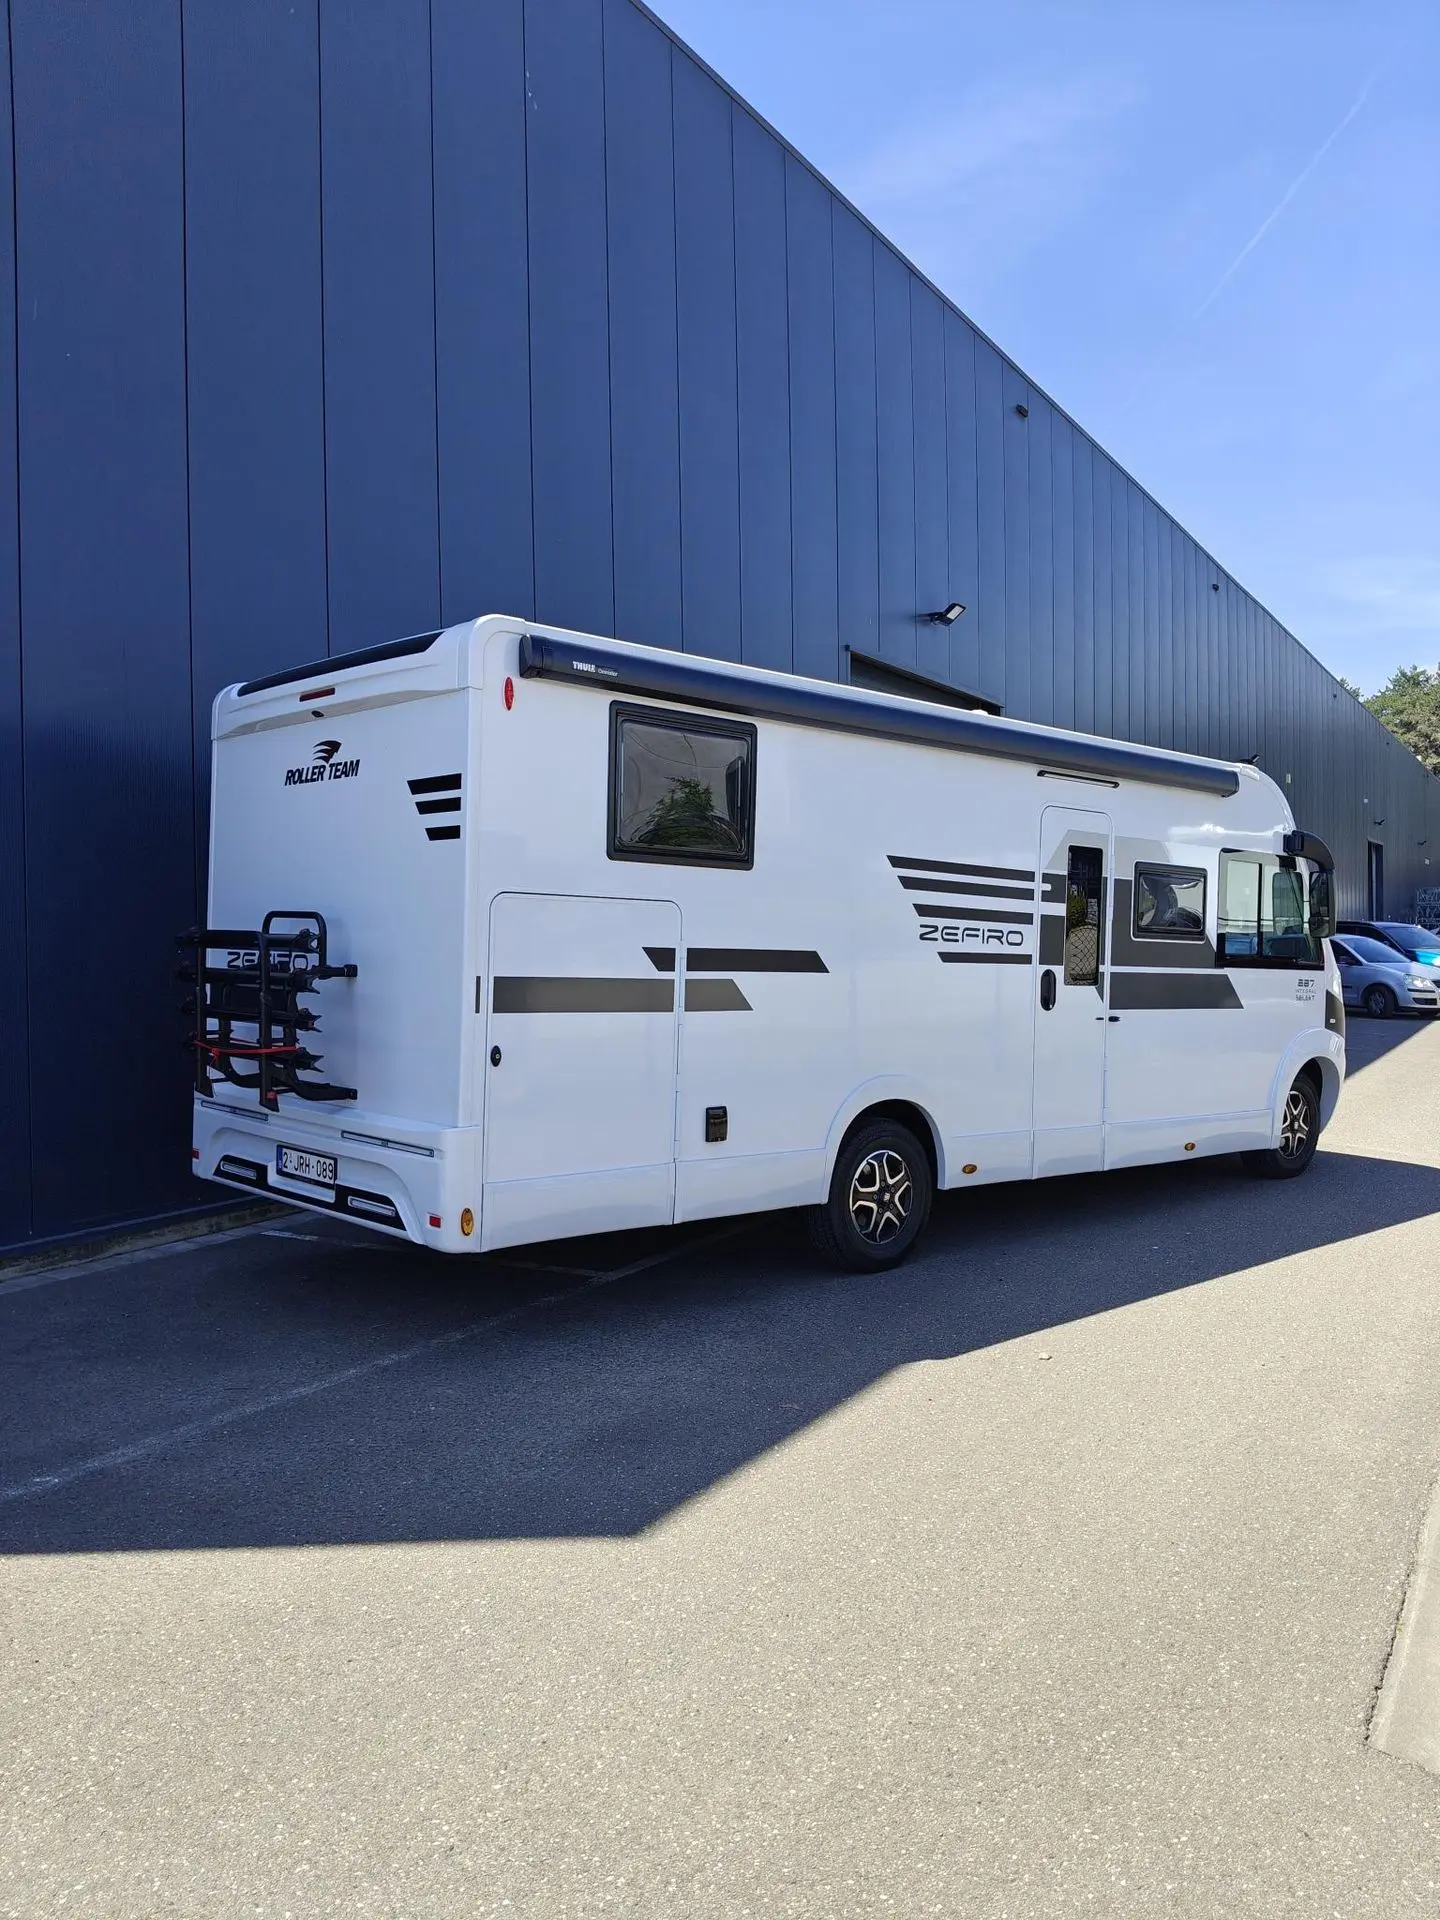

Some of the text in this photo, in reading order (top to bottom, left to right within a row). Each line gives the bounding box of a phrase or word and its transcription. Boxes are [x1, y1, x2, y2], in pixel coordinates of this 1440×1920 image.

[572, 660, 596, 673] THULE
[284, 759, 361, 786] ROLLER TEAM
[919, 924, 1024, 946] ZEFIRO
